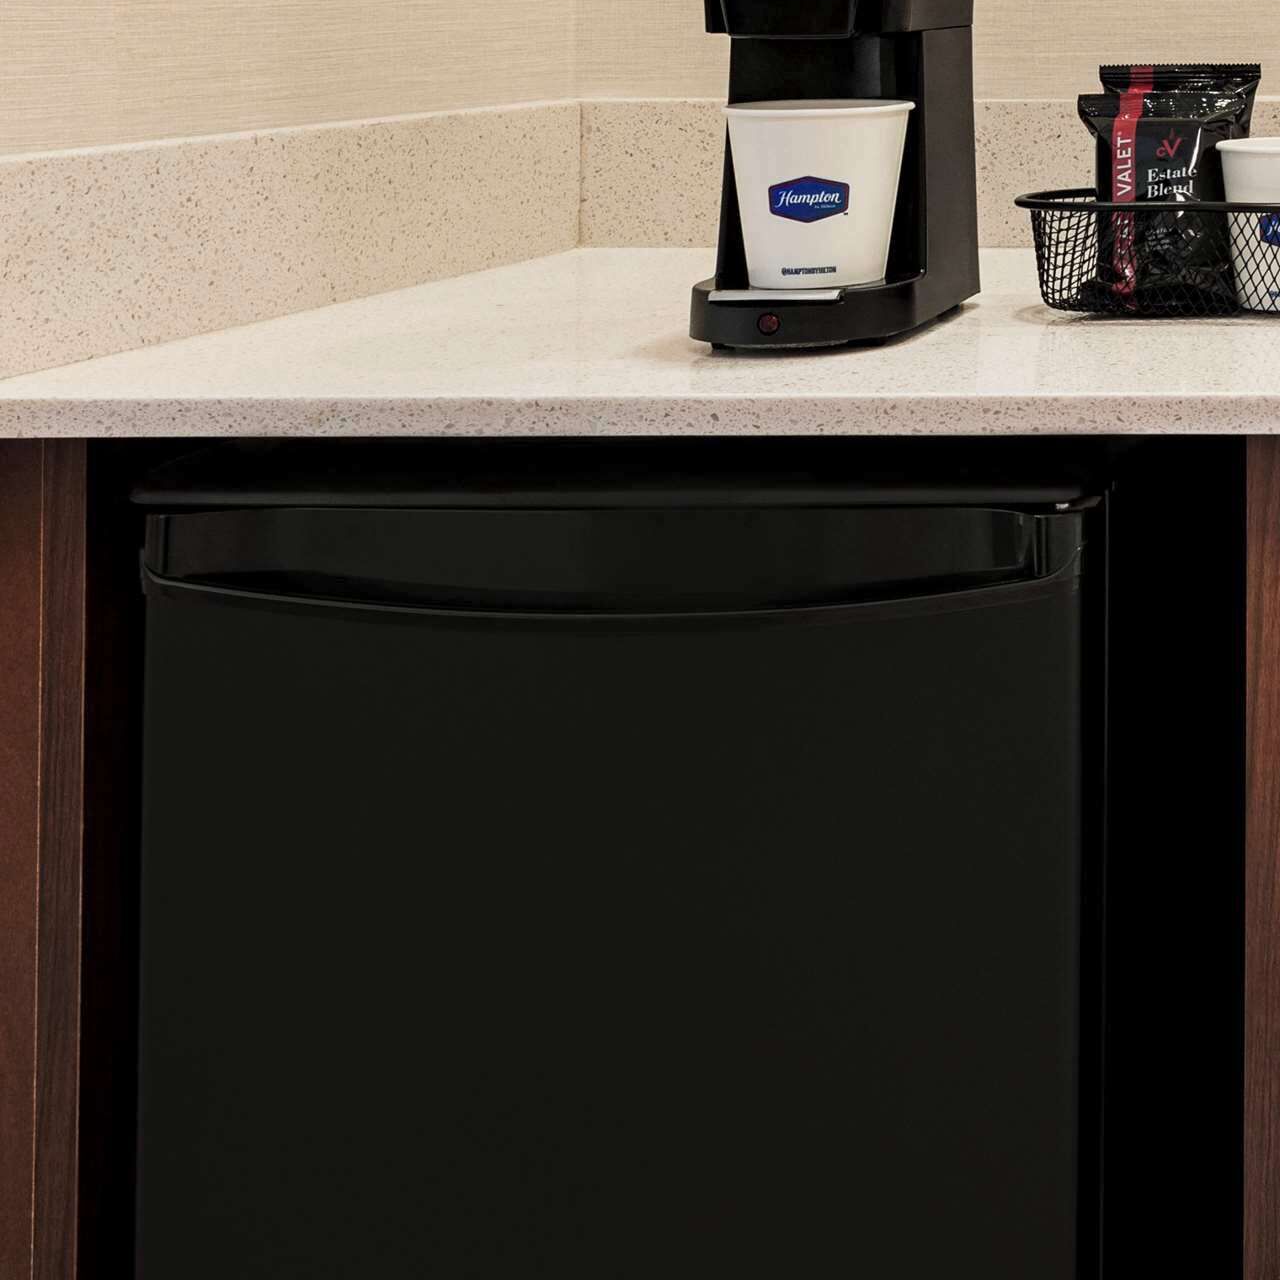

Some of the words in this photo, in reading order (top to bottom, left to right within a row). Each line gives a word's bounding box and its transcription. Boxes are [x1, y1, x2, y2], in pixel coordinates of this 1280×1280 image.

[1116, 136, 1133, 197] VALET
[1147, 166, 1198, 183] Estate
[1147, 179, 1194, 199] Blend
[774, 190, 841, 208] Hampton
